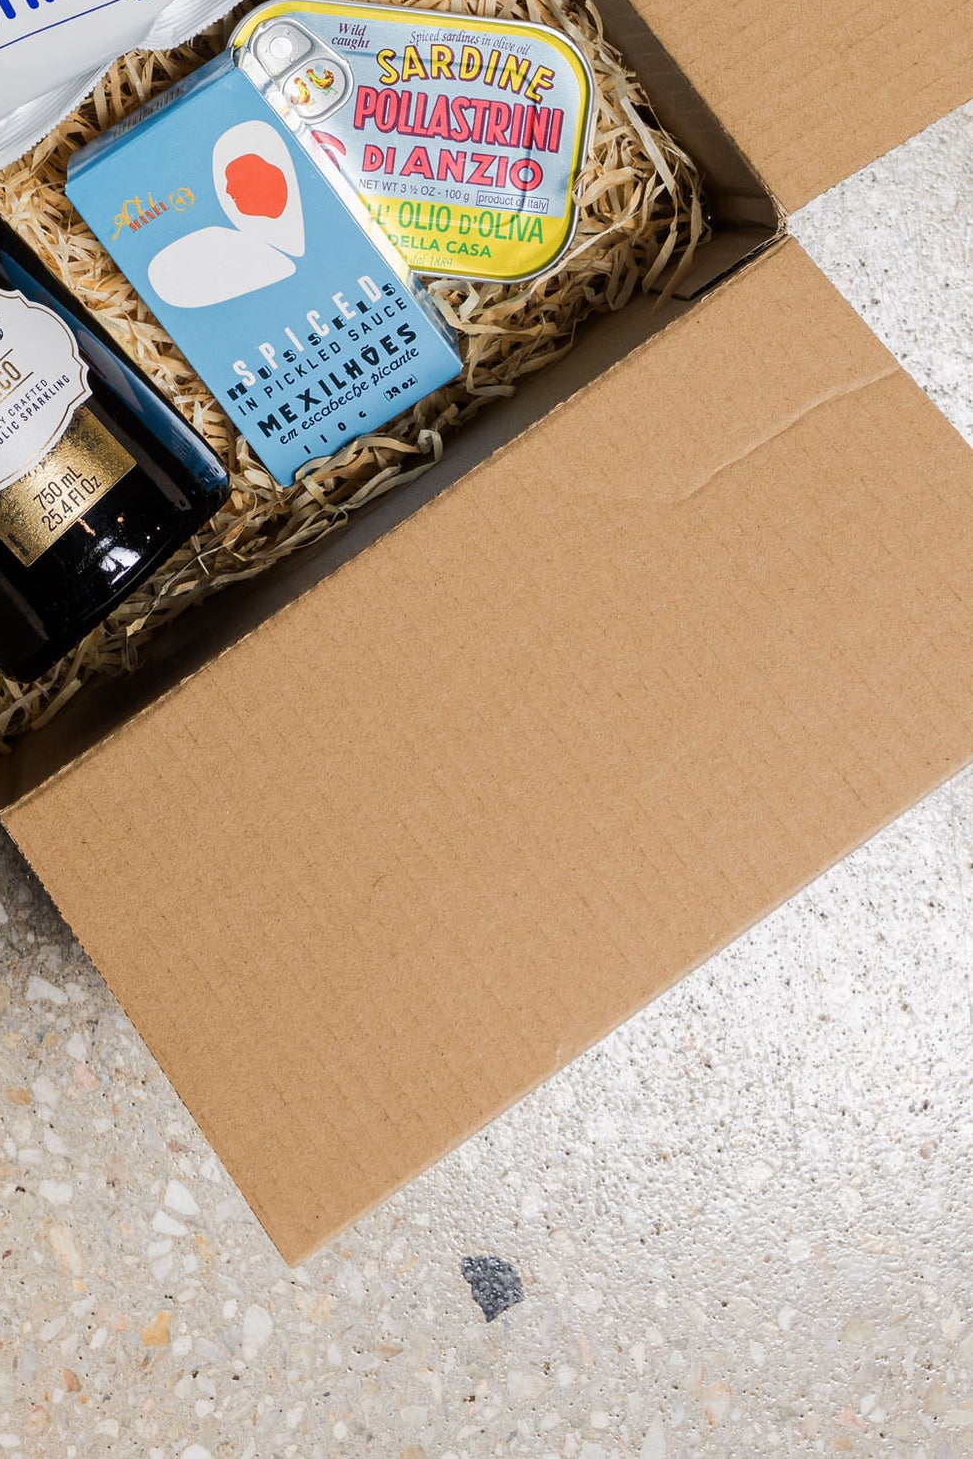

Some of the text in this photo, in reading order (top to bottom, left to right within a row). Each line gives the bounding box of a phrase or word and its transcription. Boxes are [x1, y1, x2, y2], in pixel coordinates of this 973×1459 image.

[331, 36, 370, 49] caught
[338, 23, 367, 36] Wild
[409, 29, 532, 55] Spiced sardines in olive oil
[376, 43, 556, 104] SARDINE
[353, 85, 565, 153] POLLASTRINI
[362, 143, 544, 192] DI ANZIO
[359, 178, 380, 189] NET
[381, 181, 400, 191] WT
[400, 183, 407, 193] 3
[420, 185, 436, 196] OZ
[445, 188, 462, 199] 100
[463, 192, 470, 203] g
[478, 192, 548, 212] product of Italy
[398, 201, 452, 232] OLIO
[459, 210, 545, 244] D'OLIVA
[388, 234, 492, 258] DELLA CASA
[429, 256, 453, 268] 1889
[232, 275, 382, 387] SPICED
[237, 297, 408, 416] IN PICKLED SAUCE
[8, 379, 48, 416] CRAFTED
[20, 374, 71, 422] SPARKLING
[257, 322, 417, 439] MEXILHÕES
[279, 347, 420, 445] em escabeche picante
[402, 374, 419, 390] oz)
[33, 466, 82, 510] 750 mL
[41, 499, 73, 532] 25.4
[81, 476, 102, 494] Oz
